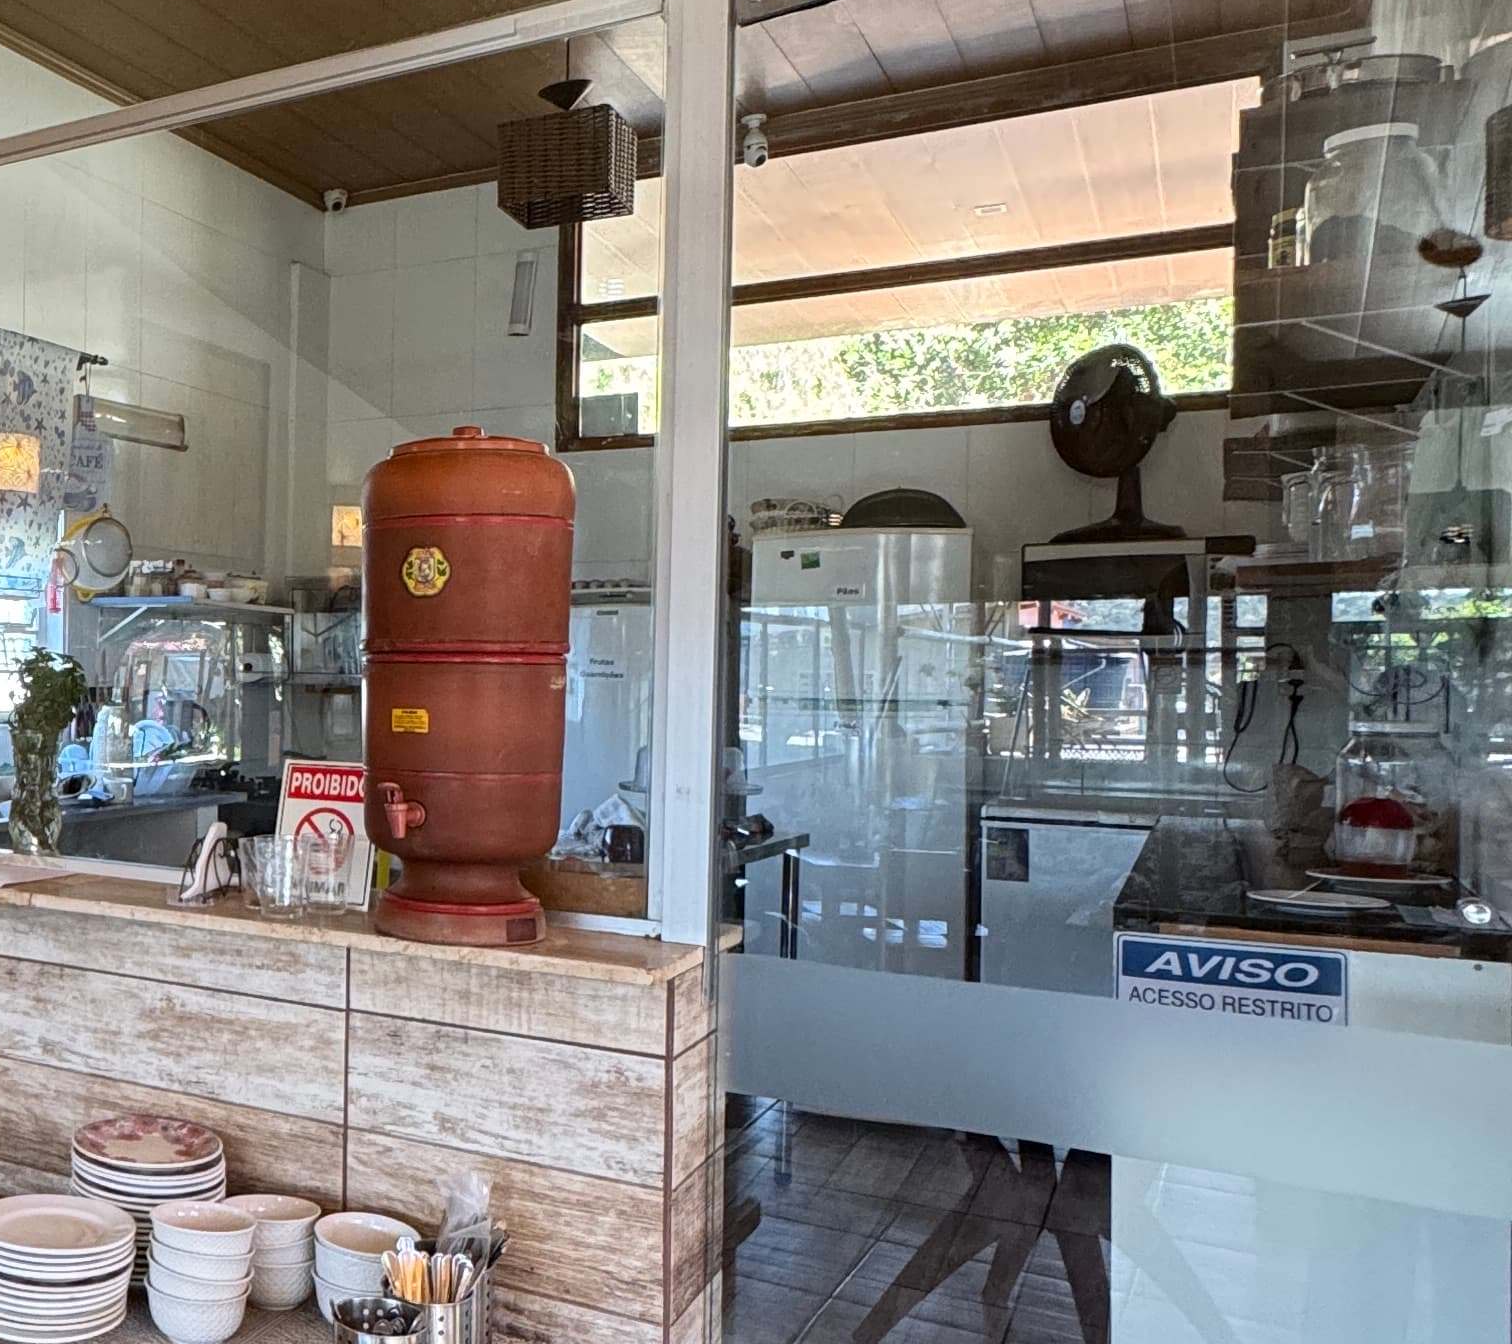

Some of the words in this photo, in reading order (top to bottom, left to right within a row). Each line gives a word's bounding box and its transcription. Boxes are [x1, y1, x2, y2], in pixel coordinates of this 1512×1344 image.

[1144, 950, 1320, 989] AVISO
[1128, 986, 1216, 1012] ACESSO
[1221, 995, 1334, 1023] RESTRITO
